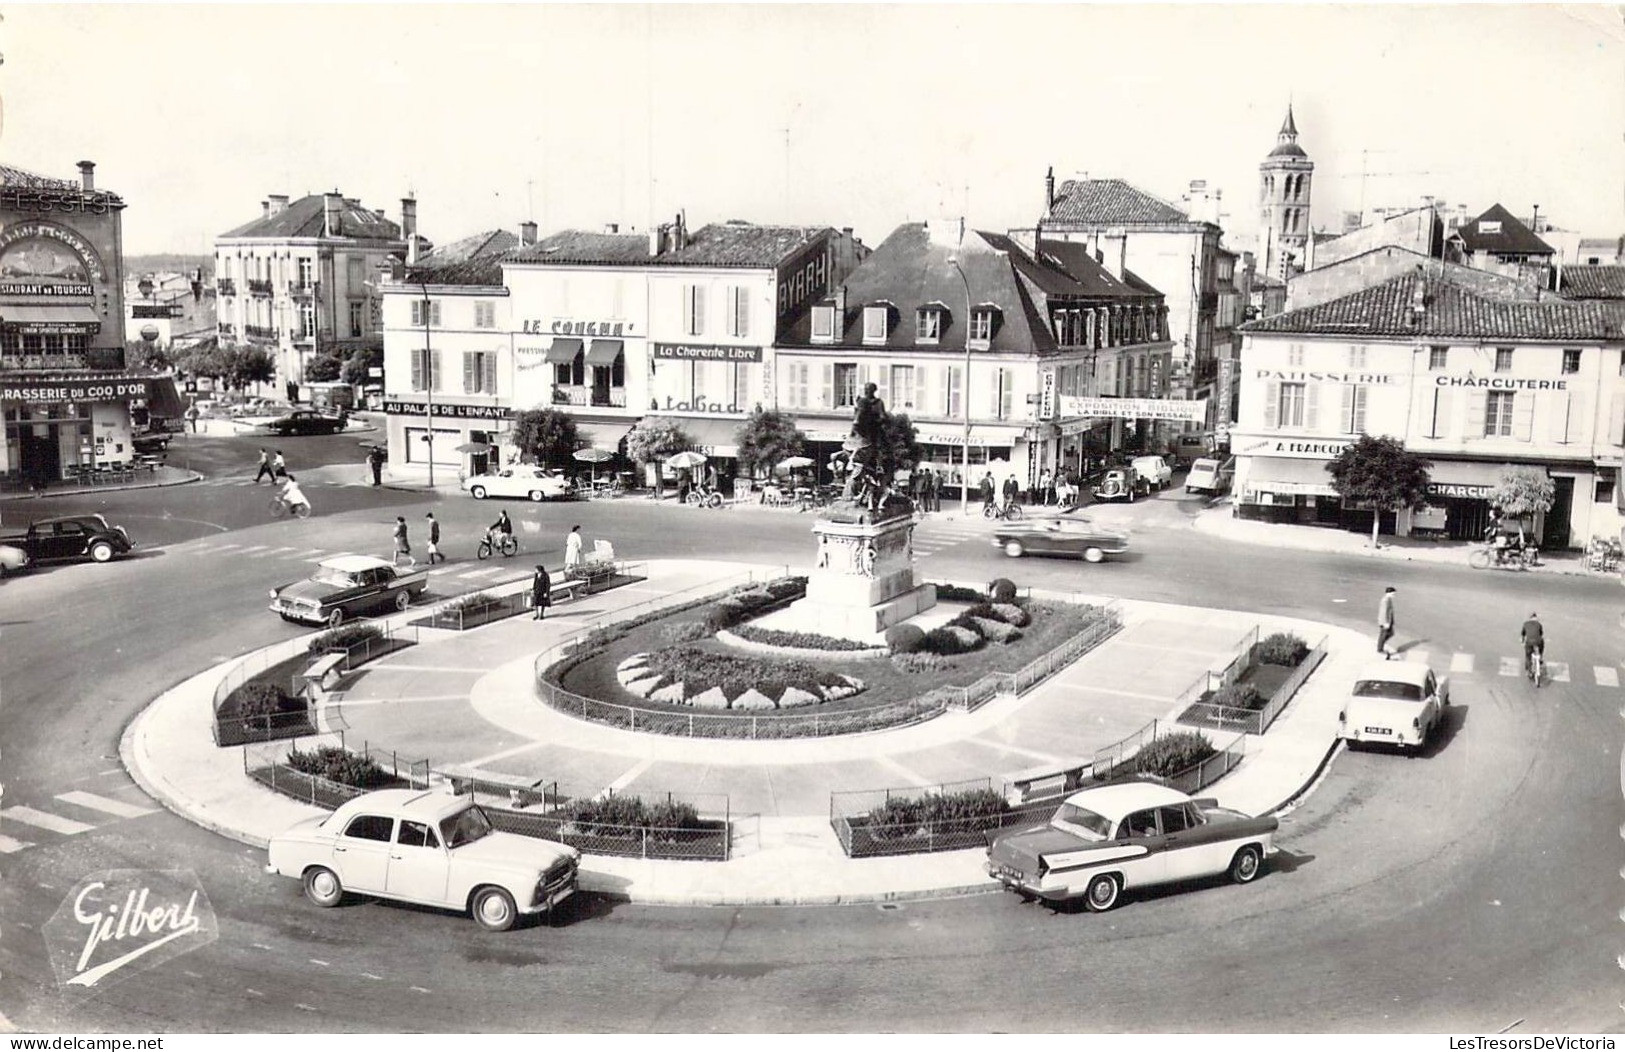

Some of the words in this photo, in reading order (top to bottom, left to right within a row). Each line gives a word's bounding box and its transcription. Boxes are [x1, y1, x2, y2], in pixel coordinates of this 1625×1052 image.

[53, 285, 92, 295] TOURISME
[780, 253, 826, 317] BYRRH
[523, 319, 541, 334] LE
[659, 345, 673, 356] La
[676, 345, 725, 358] Charente
[728, 347, 756, 359] Libre
[1435, 375, 1568, 390] CHARCUTERIE
[70, 388, 84, 398] DU
[87, 386, 114, 398] COQ
[117, 383, 146, 395] D'OR
[387, 403, 401, 412] AU
[403, 404, 439, 414] PALAS
[441, 407, 454, 415] DE
[457, 407, 505, 417] L'ENFANT
[1068, 402, 1141, 411] EXPOSITION
[1276, 442, 1285, 451] A
